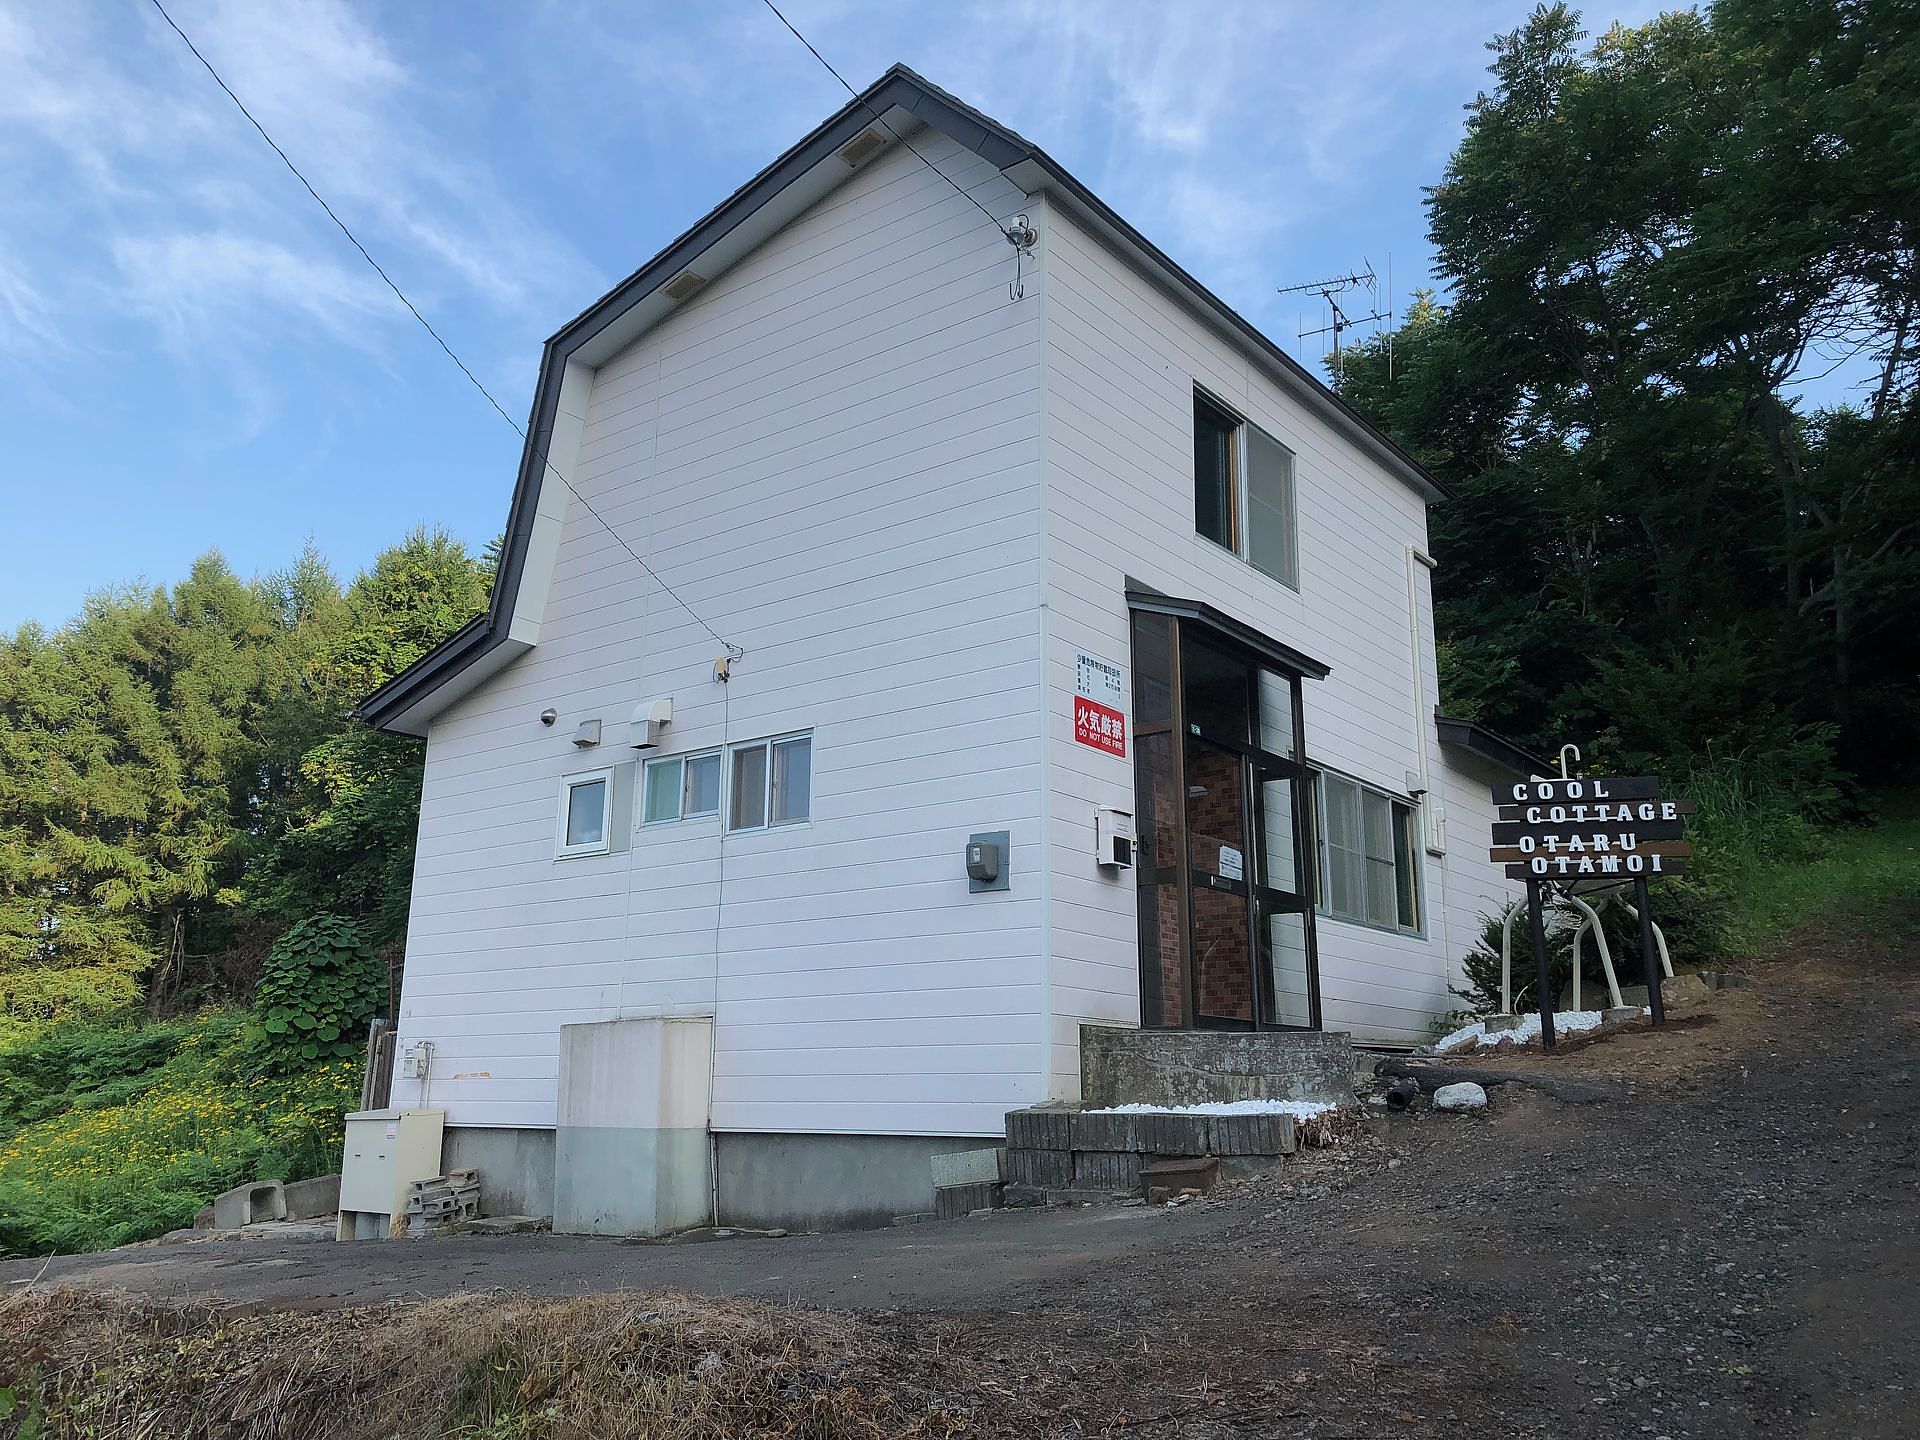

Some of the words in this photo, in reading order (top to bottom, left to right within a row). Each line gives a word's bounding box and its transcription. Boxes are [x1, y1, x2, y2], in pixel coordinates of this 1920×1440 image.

[1078, 706, 1122, 740] 火気厳禁
[1078, 727, 1087, 737] DO
[1090, 731, 1100, 742] NOT
[1101, 735, 1111, 746] USE
[1112, 740, 1123, 751] FIRE
[1512, 781, 1609, 801] COOL
[1526, 802, 1677, 824] COTTAGE
[1519, 833, 1636, 853] OTARU
[1531, 854, 1662, 874] OTAMOI
